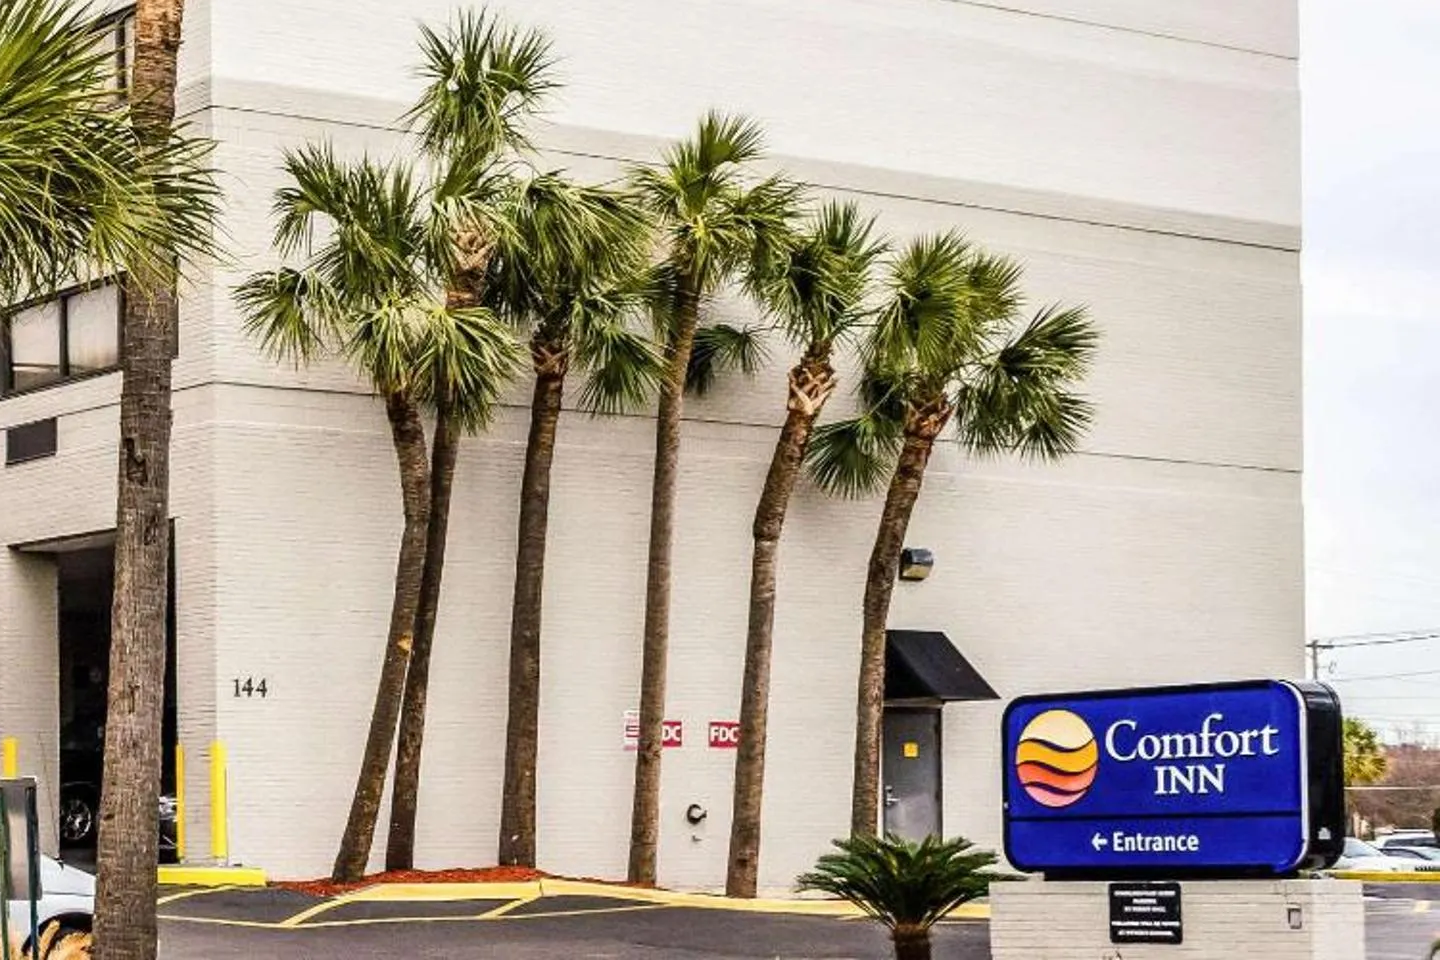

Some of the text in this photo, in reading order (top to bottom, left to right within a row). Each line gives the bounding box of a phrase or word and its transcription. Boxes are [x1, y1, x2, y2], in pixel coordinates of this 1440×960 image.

[233, 677, 267, 698] 144
[661, 725, 681, 741] DC
[710, 726, 740, 742] FDC
[1105, 713, 1279, 761] Comfort
[1154, 764, 1225, 794] INN
[1113, 832, 1199, 851] Entrance
